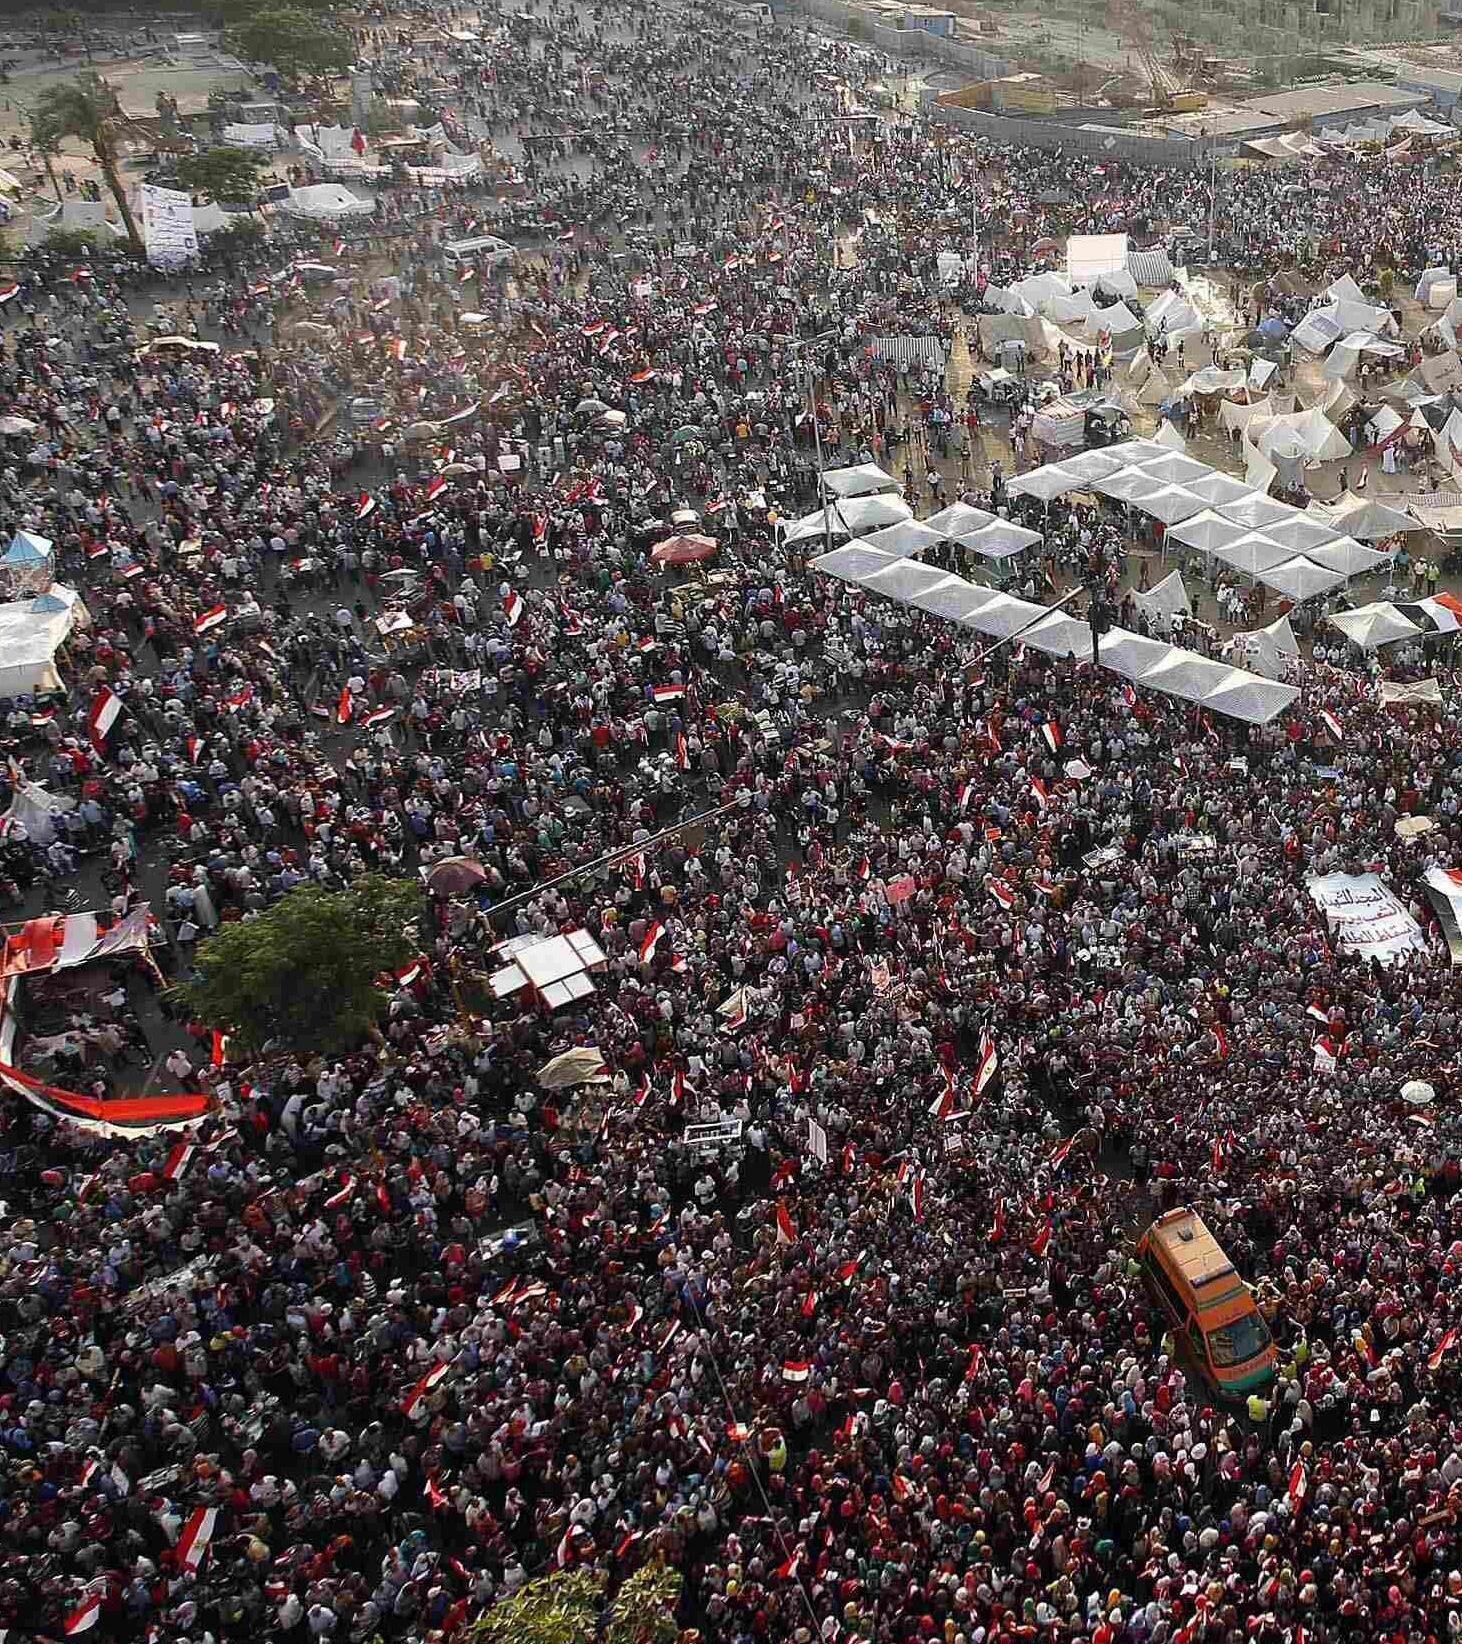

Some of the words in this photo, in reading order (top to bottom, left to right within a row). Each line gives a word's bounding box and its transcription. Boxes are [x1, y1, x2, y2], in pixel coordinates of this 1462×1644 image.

[1319, 888, 1355, 908] للشهداء
[1355, 885, 1388, 907] المجد
[1362, 901, 1403, 926] الشعب
